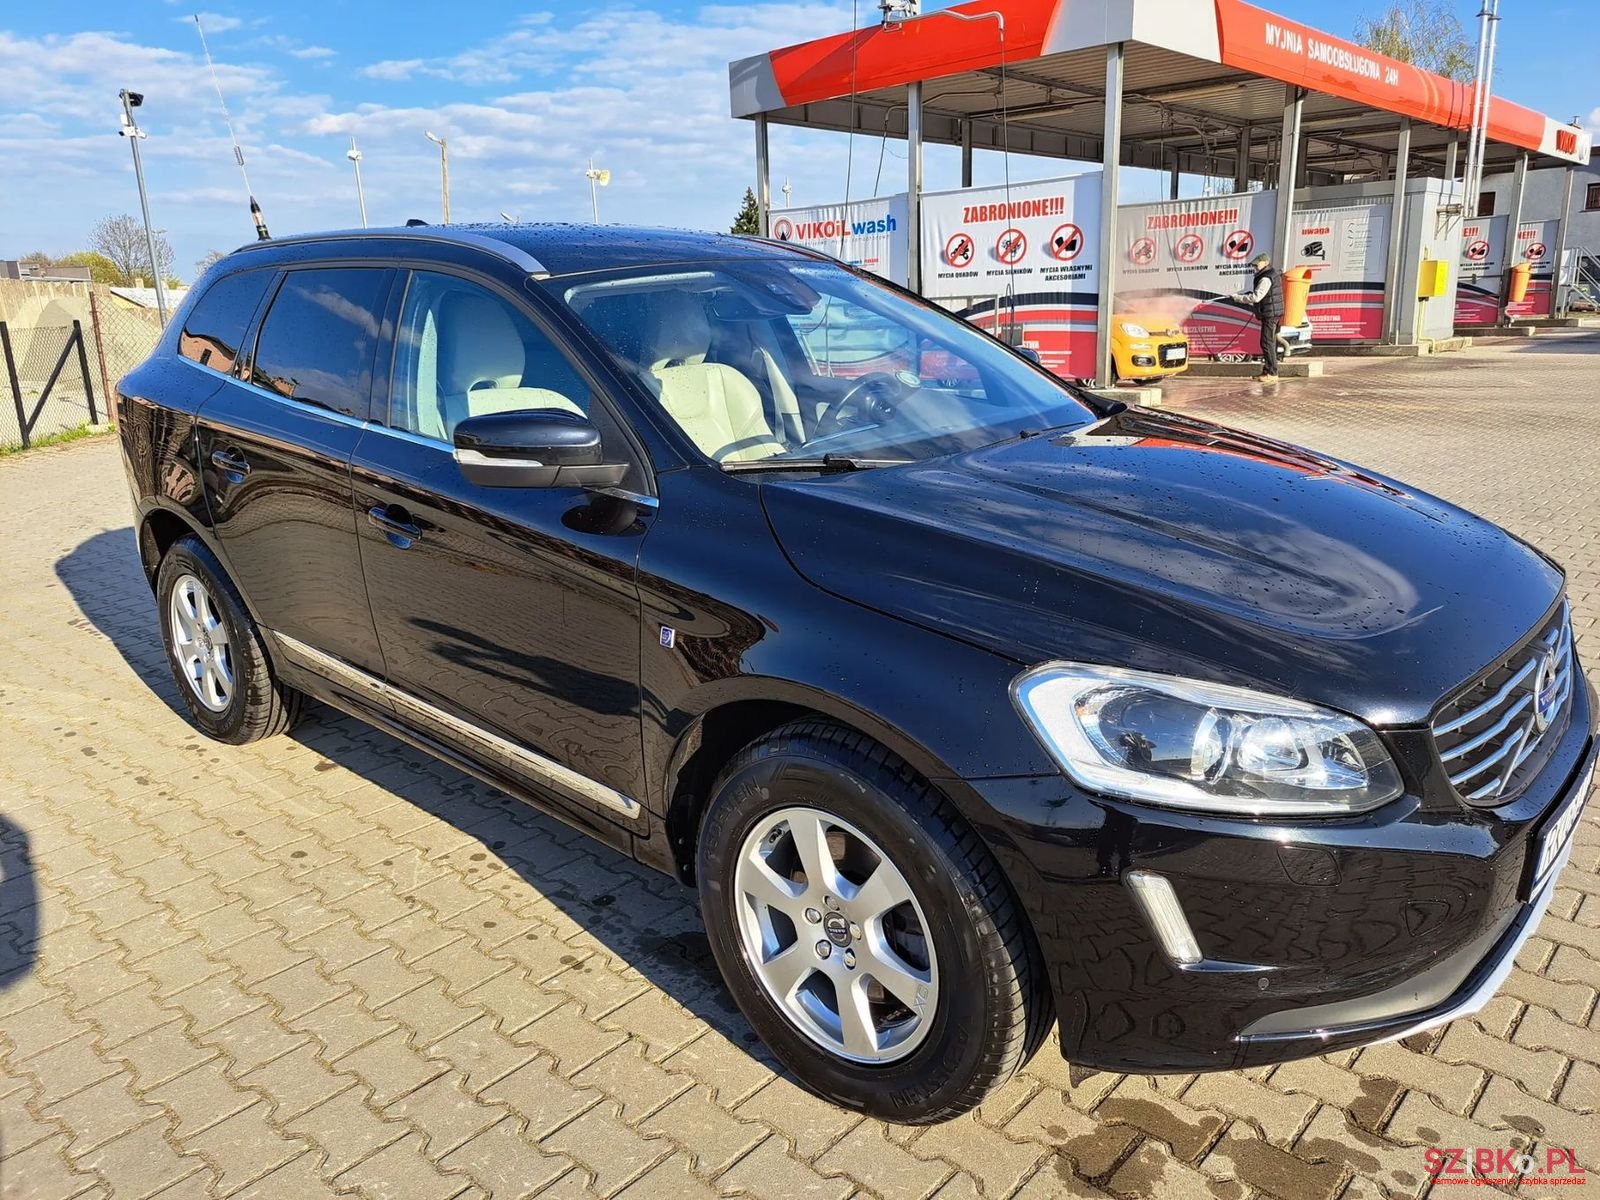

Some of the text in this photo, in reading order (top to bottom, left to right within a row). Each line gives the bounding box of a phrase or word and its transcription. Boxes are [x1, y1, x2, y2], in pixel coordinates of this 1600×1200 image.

[1265, 23, 1303, 55] MYJNIA
[1385, 65, 1398, 86] 24H
[963, 197, 1064, 223] ZABRONIONE!!!
[1147, 209, 1238, 230] ZABRONIONE!!!
